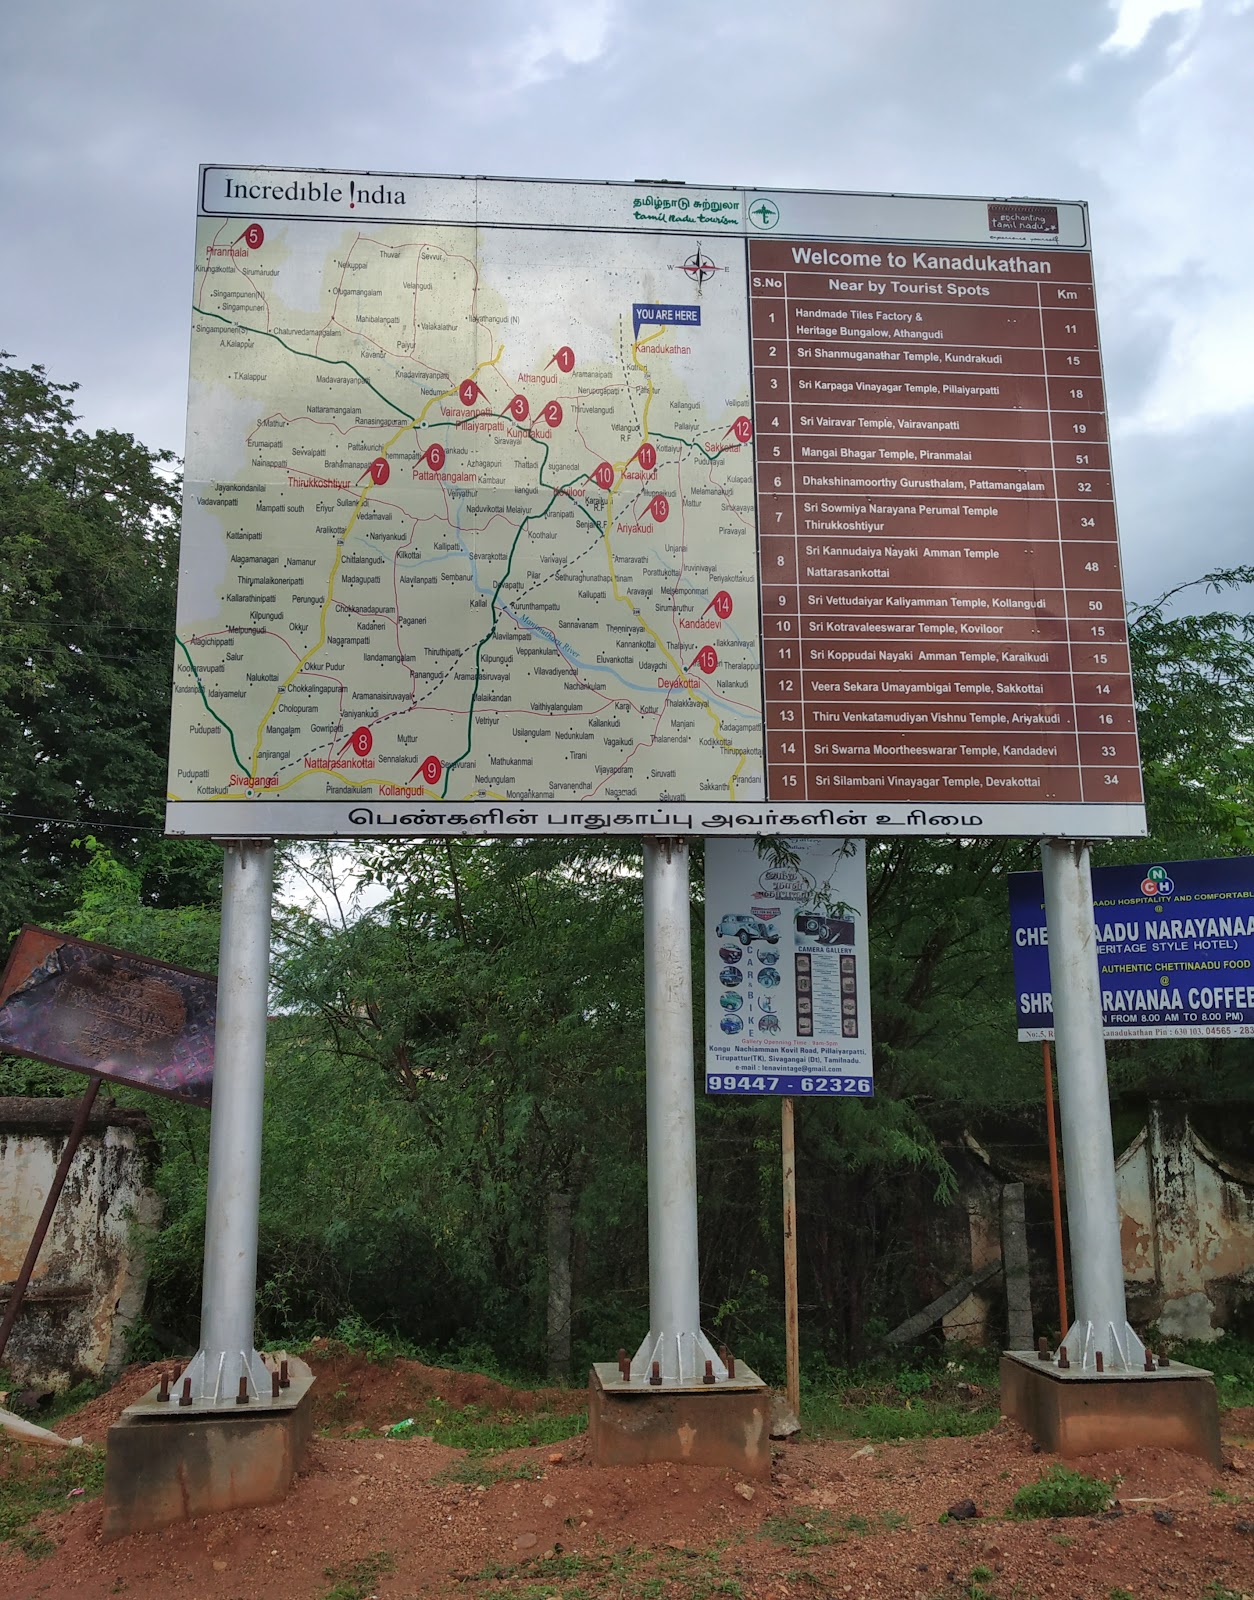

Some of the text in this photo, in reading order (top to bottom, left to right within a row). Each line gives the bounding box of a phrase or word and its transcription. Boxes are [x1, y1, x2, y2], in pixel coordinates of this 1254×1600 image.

[224, 178, 343, 202] Incredible
[633, 195, 740, 213] தமிழ்நாடு சுற்றுலா
[633, 211, 667, 223] tamil
[697, 213, 739, 225] tourism
[991, 218, 1044, 230] tamil nadu
[791, 247, 1050, 273] Welcome to Kanadukathan
[753, 278, 782, 288] S.No
[829, 278, 989, 297] Near by Tourist Spots
[1057, 289, 1077, 299] Km
[636, 308, 697, 320] YOU ARE HERE
[795, 308, 847, 318] Handmade
[850, 310, 873, 319] Tiles
[876, 310, 912, 323] Factory
[796, 325, 943, 340] Heritage Bungalow, Athangudi
[635, 343, 692, 355] Kanadukathan
[797, 347, 1002, 363] Sri Shanmuganathar Temple, Kundrakudi
[517, 372, 558, 385] Athangudi
[800, 416, 959, 431] Sri Vairavar Temple, Vairavanpatti
[412, 469, 477, 482] Pattamangalam
[803, 475, 1044, 492] Dhakshinamoorthy Gurusthalam, Pattamangalam
[256, 503, 305, 513] Mampatti south
[803, 502, 997, 517] Sri Sowmiya Narayana Perumal Temple
[616, 523, 654, 534] Ariyakudi
[806, 545, 999, 560] Sri Kannudaiya Nayaki Amman Temple
[286, 557, 317, 566] Namanur
[806, 567, 889, 577] Nattarasankottai
[341, 575, 381, 585] Madagupatti
[226, 593, 277, 603] Kallarathinipatti
[808, 595, 1045, 610] Sri Vettudaiyar Kaliyamman Temple, Kollangudi
[679, 619, 722, 630] Kandadevi
[225, 652, 244, 662] Salur
[810, 649, 1048, 663] Sri Koppudai Nayaki Amman Temple, Karaikudi
[246, 673, 279, 683] Nalukottai
[278, 704, 319, 714] Cholopuram
[812, 711, 1060, 725] Thiru Venkatamudiyan Vishnu Temple, Ariyakudi
[490, 757, 534, 766] Mathukanmai
[569, 751, 588, 760] Tirani
[304, 757, 376, 769] Nattarasankottai
[229, 774, 279, 787] Sivagangai
[815, 775, 829, 785] Sri
[833, 775, 884, 785] Silambani
[887, 776, 939, 788] Vinayagar
[941, 776, 982, 788] Temple,
[379, 785, 425, 797] Kollangudi
[348, 808, 982, 829] பெண்களின் பாதுகாப்பு அவர்களின் உரிமை
[1117, 896, 1171, 904] HOSPITALITY
[1154, 905, 1163, 913] @
[1152, 939, 1237, 951] STYLE HOTEL)
[1101, 959, 1250, 972] AUTHENTIC CHETTINAADU FOOD
[1159, 975, 1170, 987] @
[1110, 1011, 1243, 1022] FROM 8.00 AM TO 8.00 PM)
[1155, 1028, 1168, 1036] Pin
[1174, 1028, 1187, 1036] 630
[1205, 1027, 1231, 1035] 04565
[768, 1055, 806, 1063] Sivagangai
[761, 1064, 841, 1072] lenavintage@gmail.com
[709, 1076, 778, 1090] 99447
[801, 1077, 869, 1092] 62326
